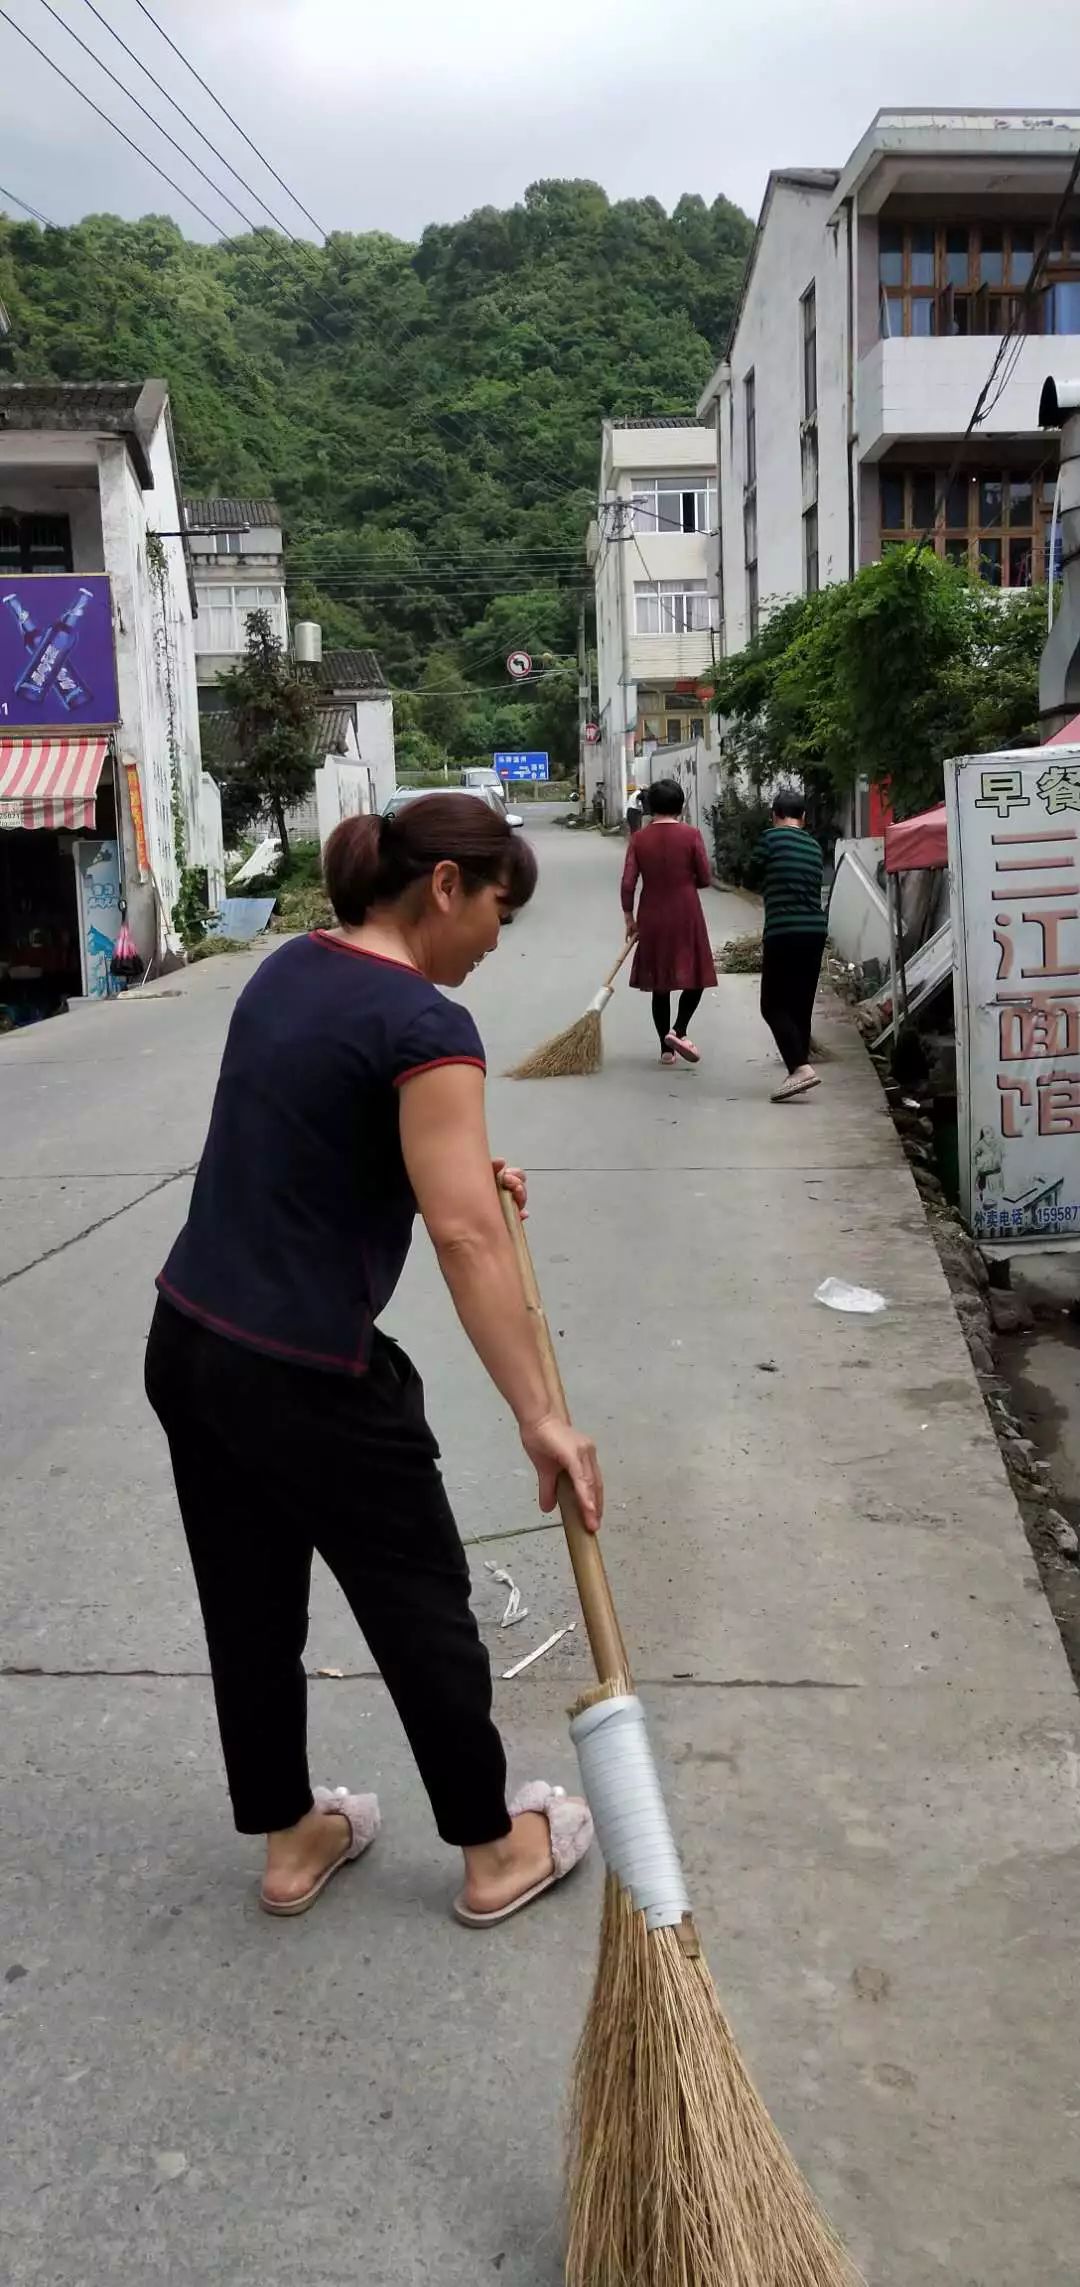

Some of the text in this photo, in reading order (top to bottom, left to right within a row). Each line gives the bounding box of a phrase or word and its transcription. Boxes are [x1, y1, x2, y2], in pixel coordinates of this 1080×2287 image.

[975, 765, 1080, 818] 早餐
[991, 829, 1080, 1138] 三江面馆
